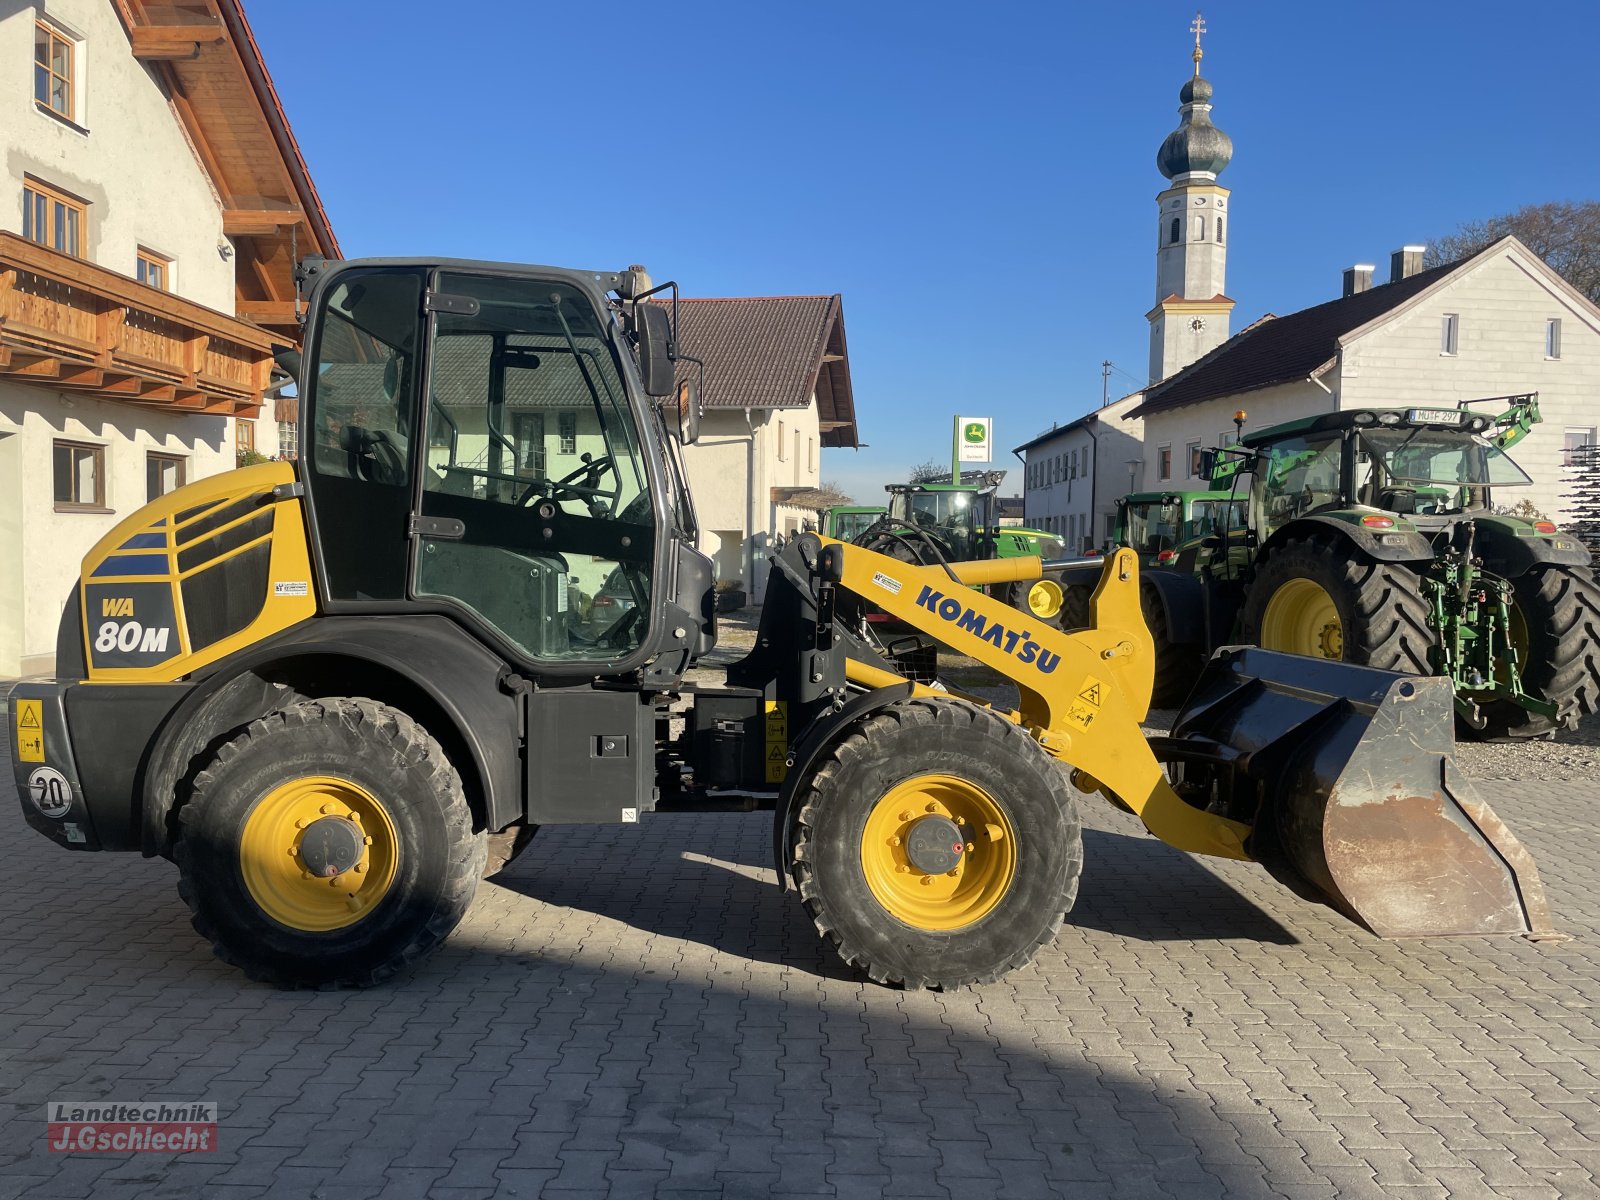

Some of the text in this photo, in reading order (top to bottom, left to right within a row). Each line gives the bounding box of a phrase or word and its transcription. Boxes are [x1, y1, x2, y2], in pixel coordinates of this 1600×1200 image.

[1434, 411, 1440, 420] F
[1442, 412, 1457, 422] 297
[102, 598, 134, 617] WA
[95, 621, 170, 652] 80M
[916, 585, 1061, 674] KOMATSU
[36, 777, 65, 810] 20
